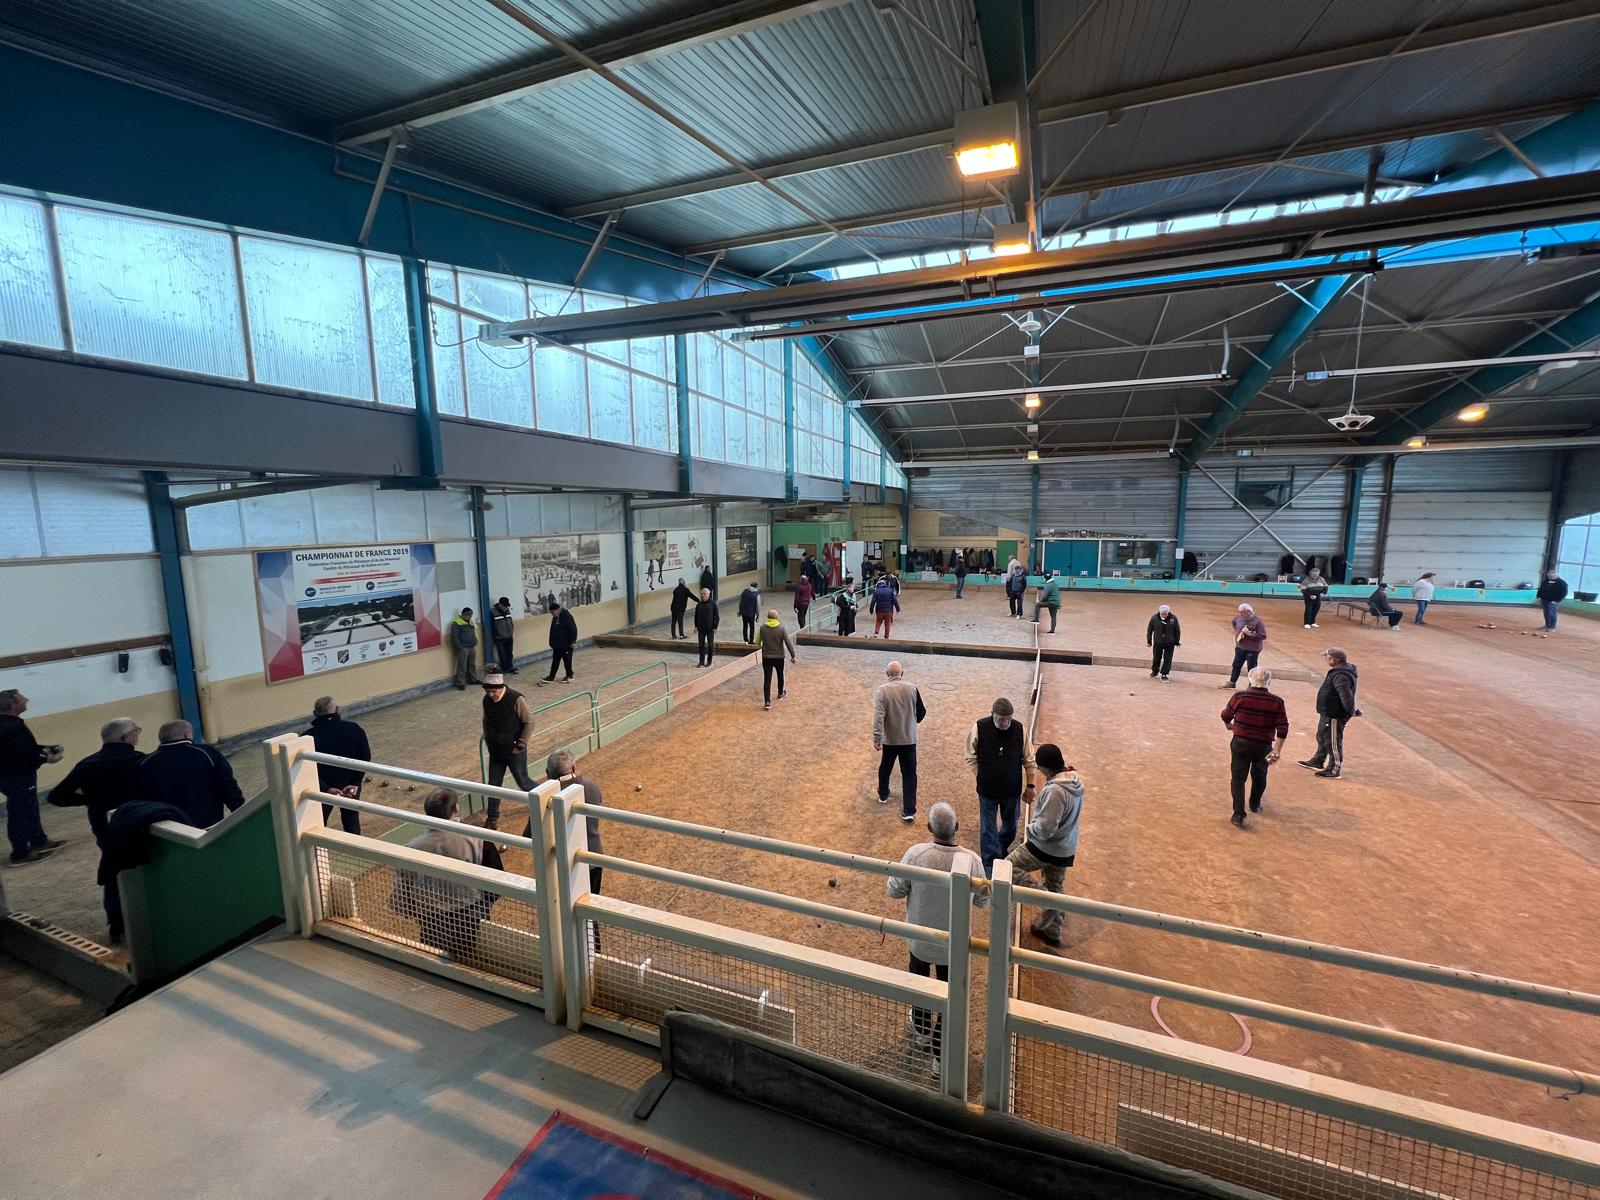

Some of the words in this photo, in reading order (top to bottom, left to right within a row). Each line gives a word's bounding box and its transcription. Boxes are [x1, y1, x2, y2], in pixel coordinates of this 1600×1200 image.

[296, 551, 353, 561] CHAMPIONNAT
[355, 550, 365, 558] DE
[366, 549, 391, 557] FRANCE
[393, 548, 409, 556] 2019
